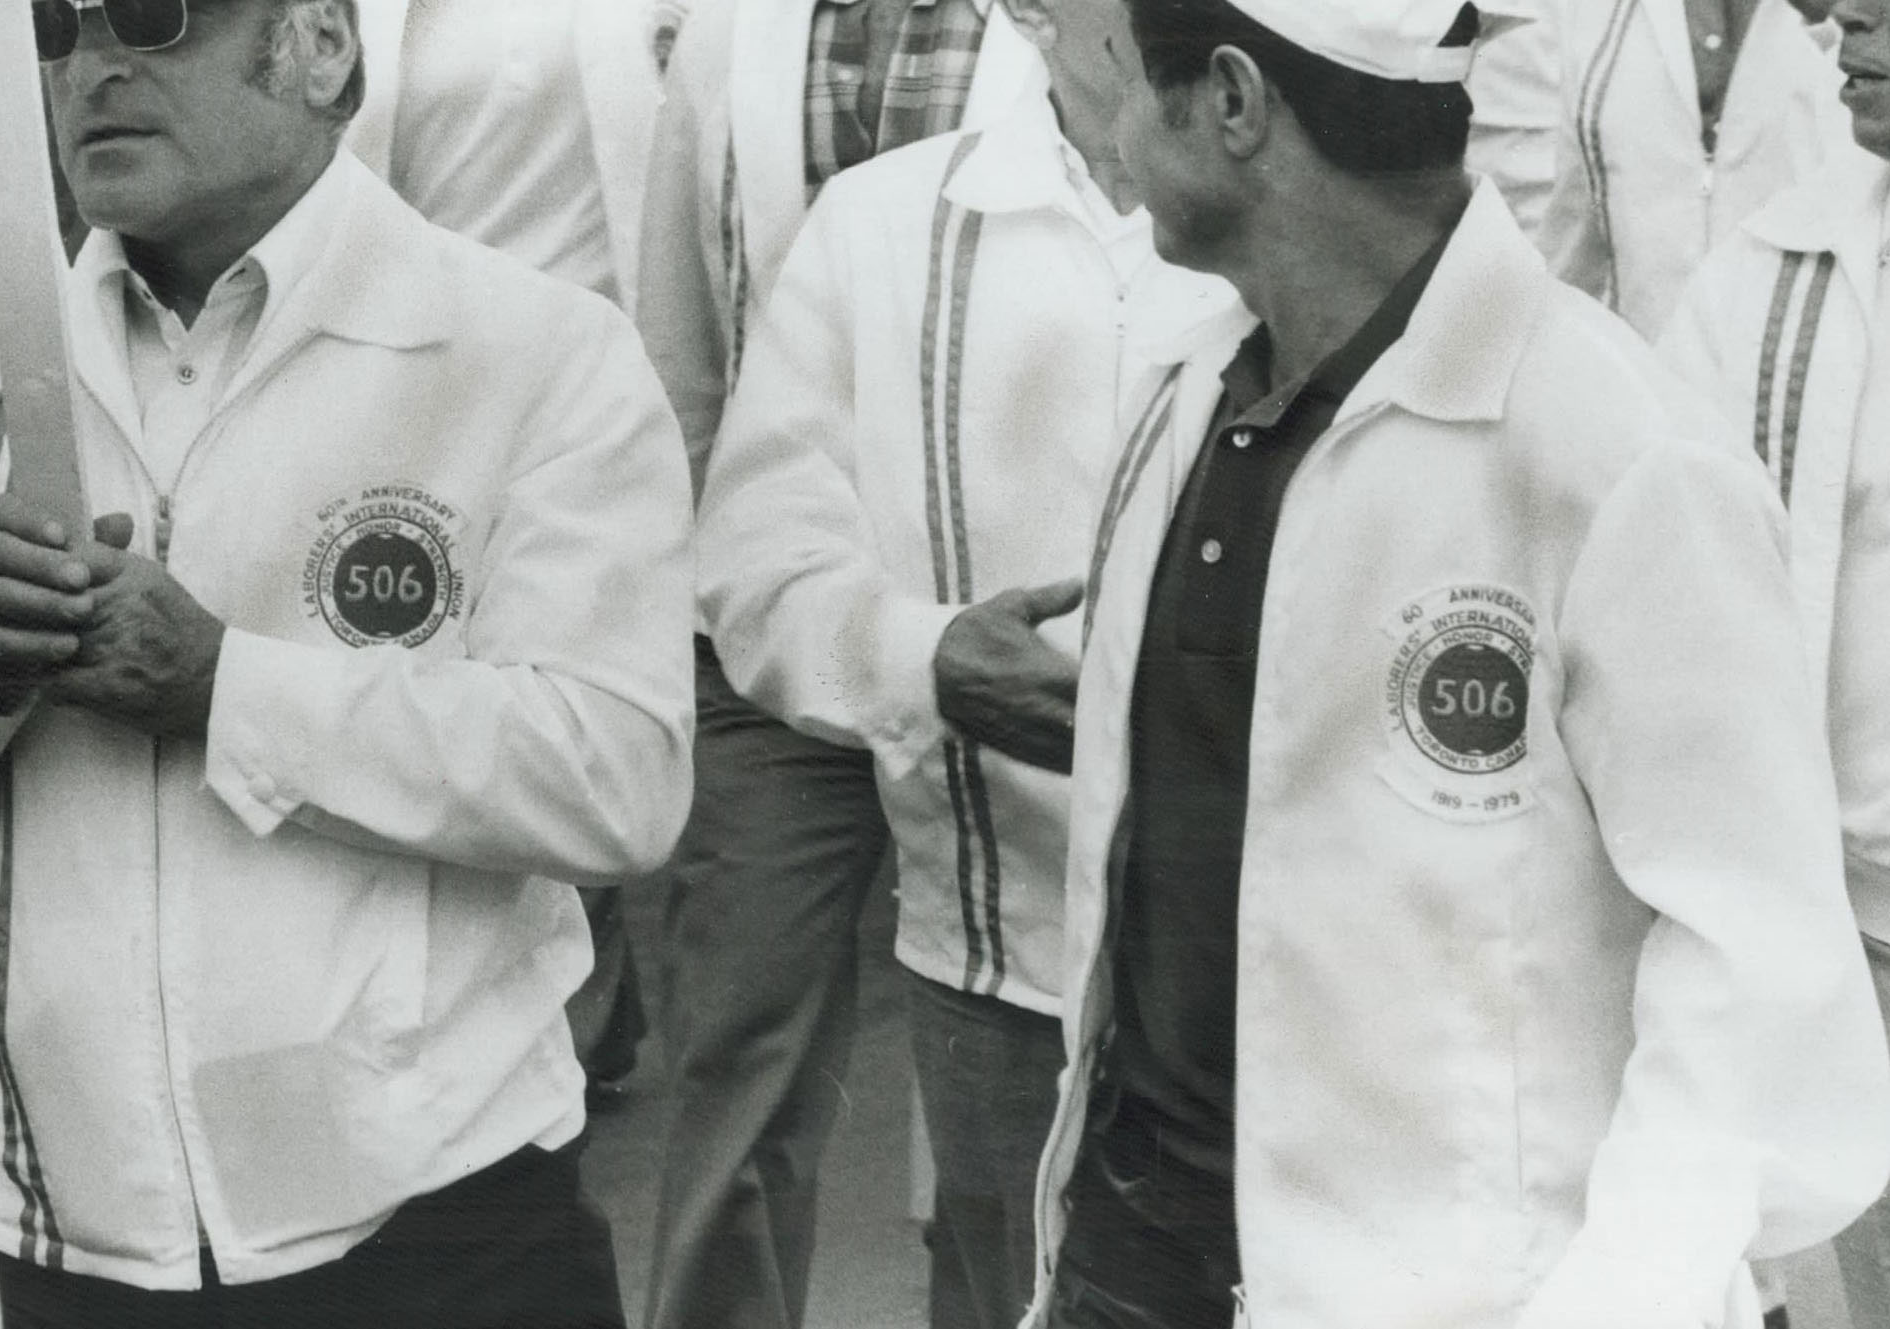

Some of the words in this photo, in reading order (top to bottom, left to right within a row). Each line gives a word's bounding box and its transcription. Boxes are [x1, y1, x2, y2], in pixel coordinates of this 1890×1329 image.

[361, 485, 457, 521] ANNIVERSARY
[342, 502, 457, 556] INTERNATIONAL
[448, 568, 465, 621] UNION
[355, 521, 402, 536] HONOR
[416, 533, 447, 601] STRENGTH
[343, 562, 424, 605] 506
[1442, 630, 1495, 647] HONOR
[1430, 677, 1516, 720] 506
[1414, 724, 1480, 771] TORONTO
[1431, 789, 1464, 810] 1919
[1482, 790, 1522, 813] 1979
